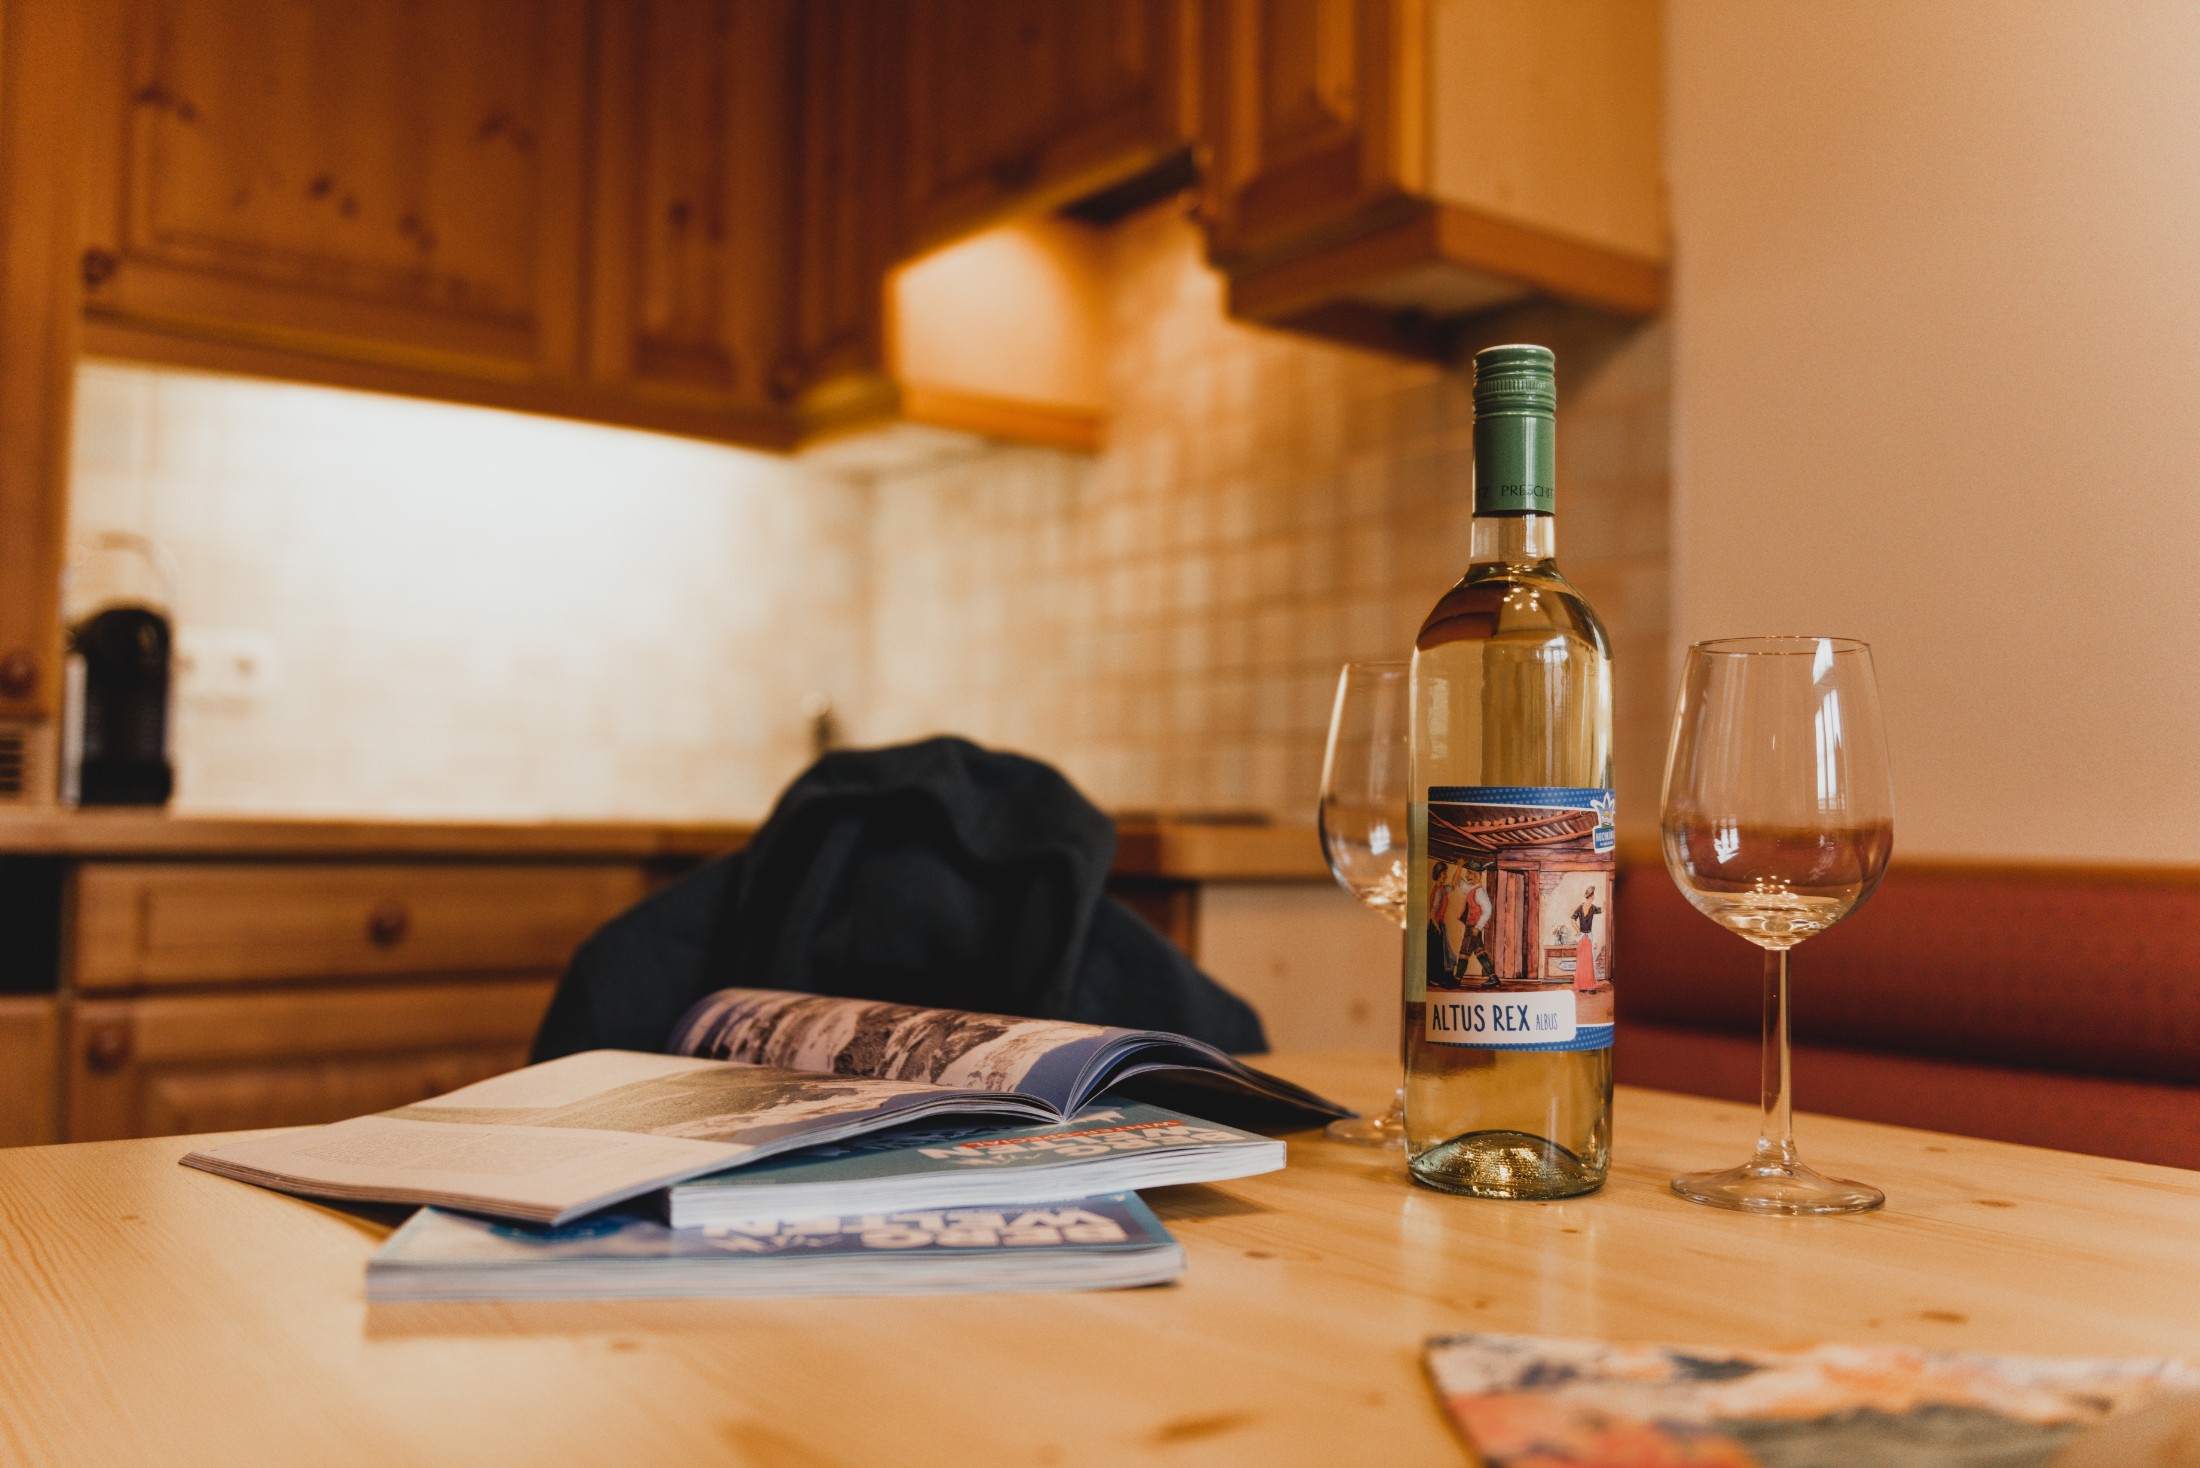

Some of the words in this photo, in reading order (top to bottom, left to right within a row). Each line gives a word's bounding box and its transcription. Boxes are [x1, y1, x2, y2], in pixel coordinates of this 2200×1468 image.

[1433, 1004, 1486, 1032] ALTUS
[1493, 1005, 1530, 1032] REX
[1536, 1013, 1558, 1031] ALBUS
[917, 1126, 1218, 1159] WELTEN
[1053, 1131, 1245, 1157] BERG
[702, 1206, 1115, 1237] WELTEN
[860, 1223, 1128, 1249] BERG
